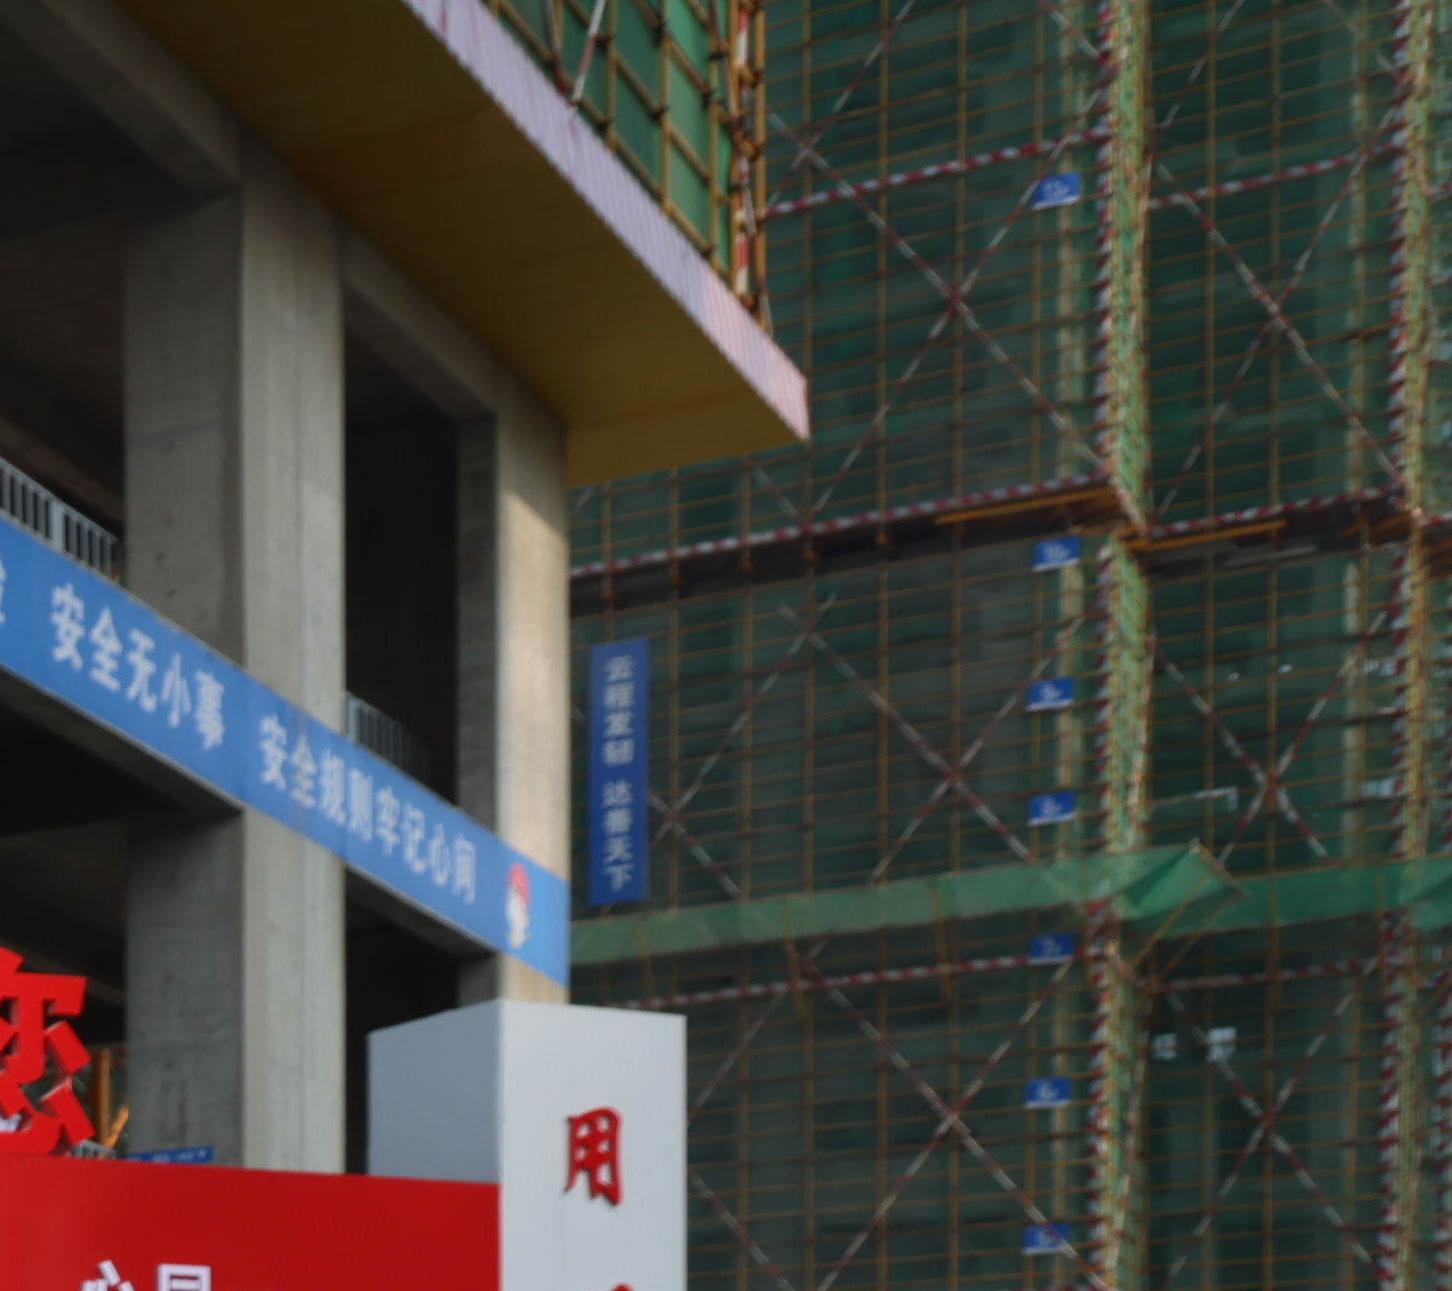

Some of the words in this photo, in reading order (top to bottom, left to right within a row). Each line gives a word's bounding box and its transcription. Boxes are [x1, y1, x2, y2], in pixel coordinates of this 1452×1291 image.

[51, 583, 225, 750] 安全无小事
